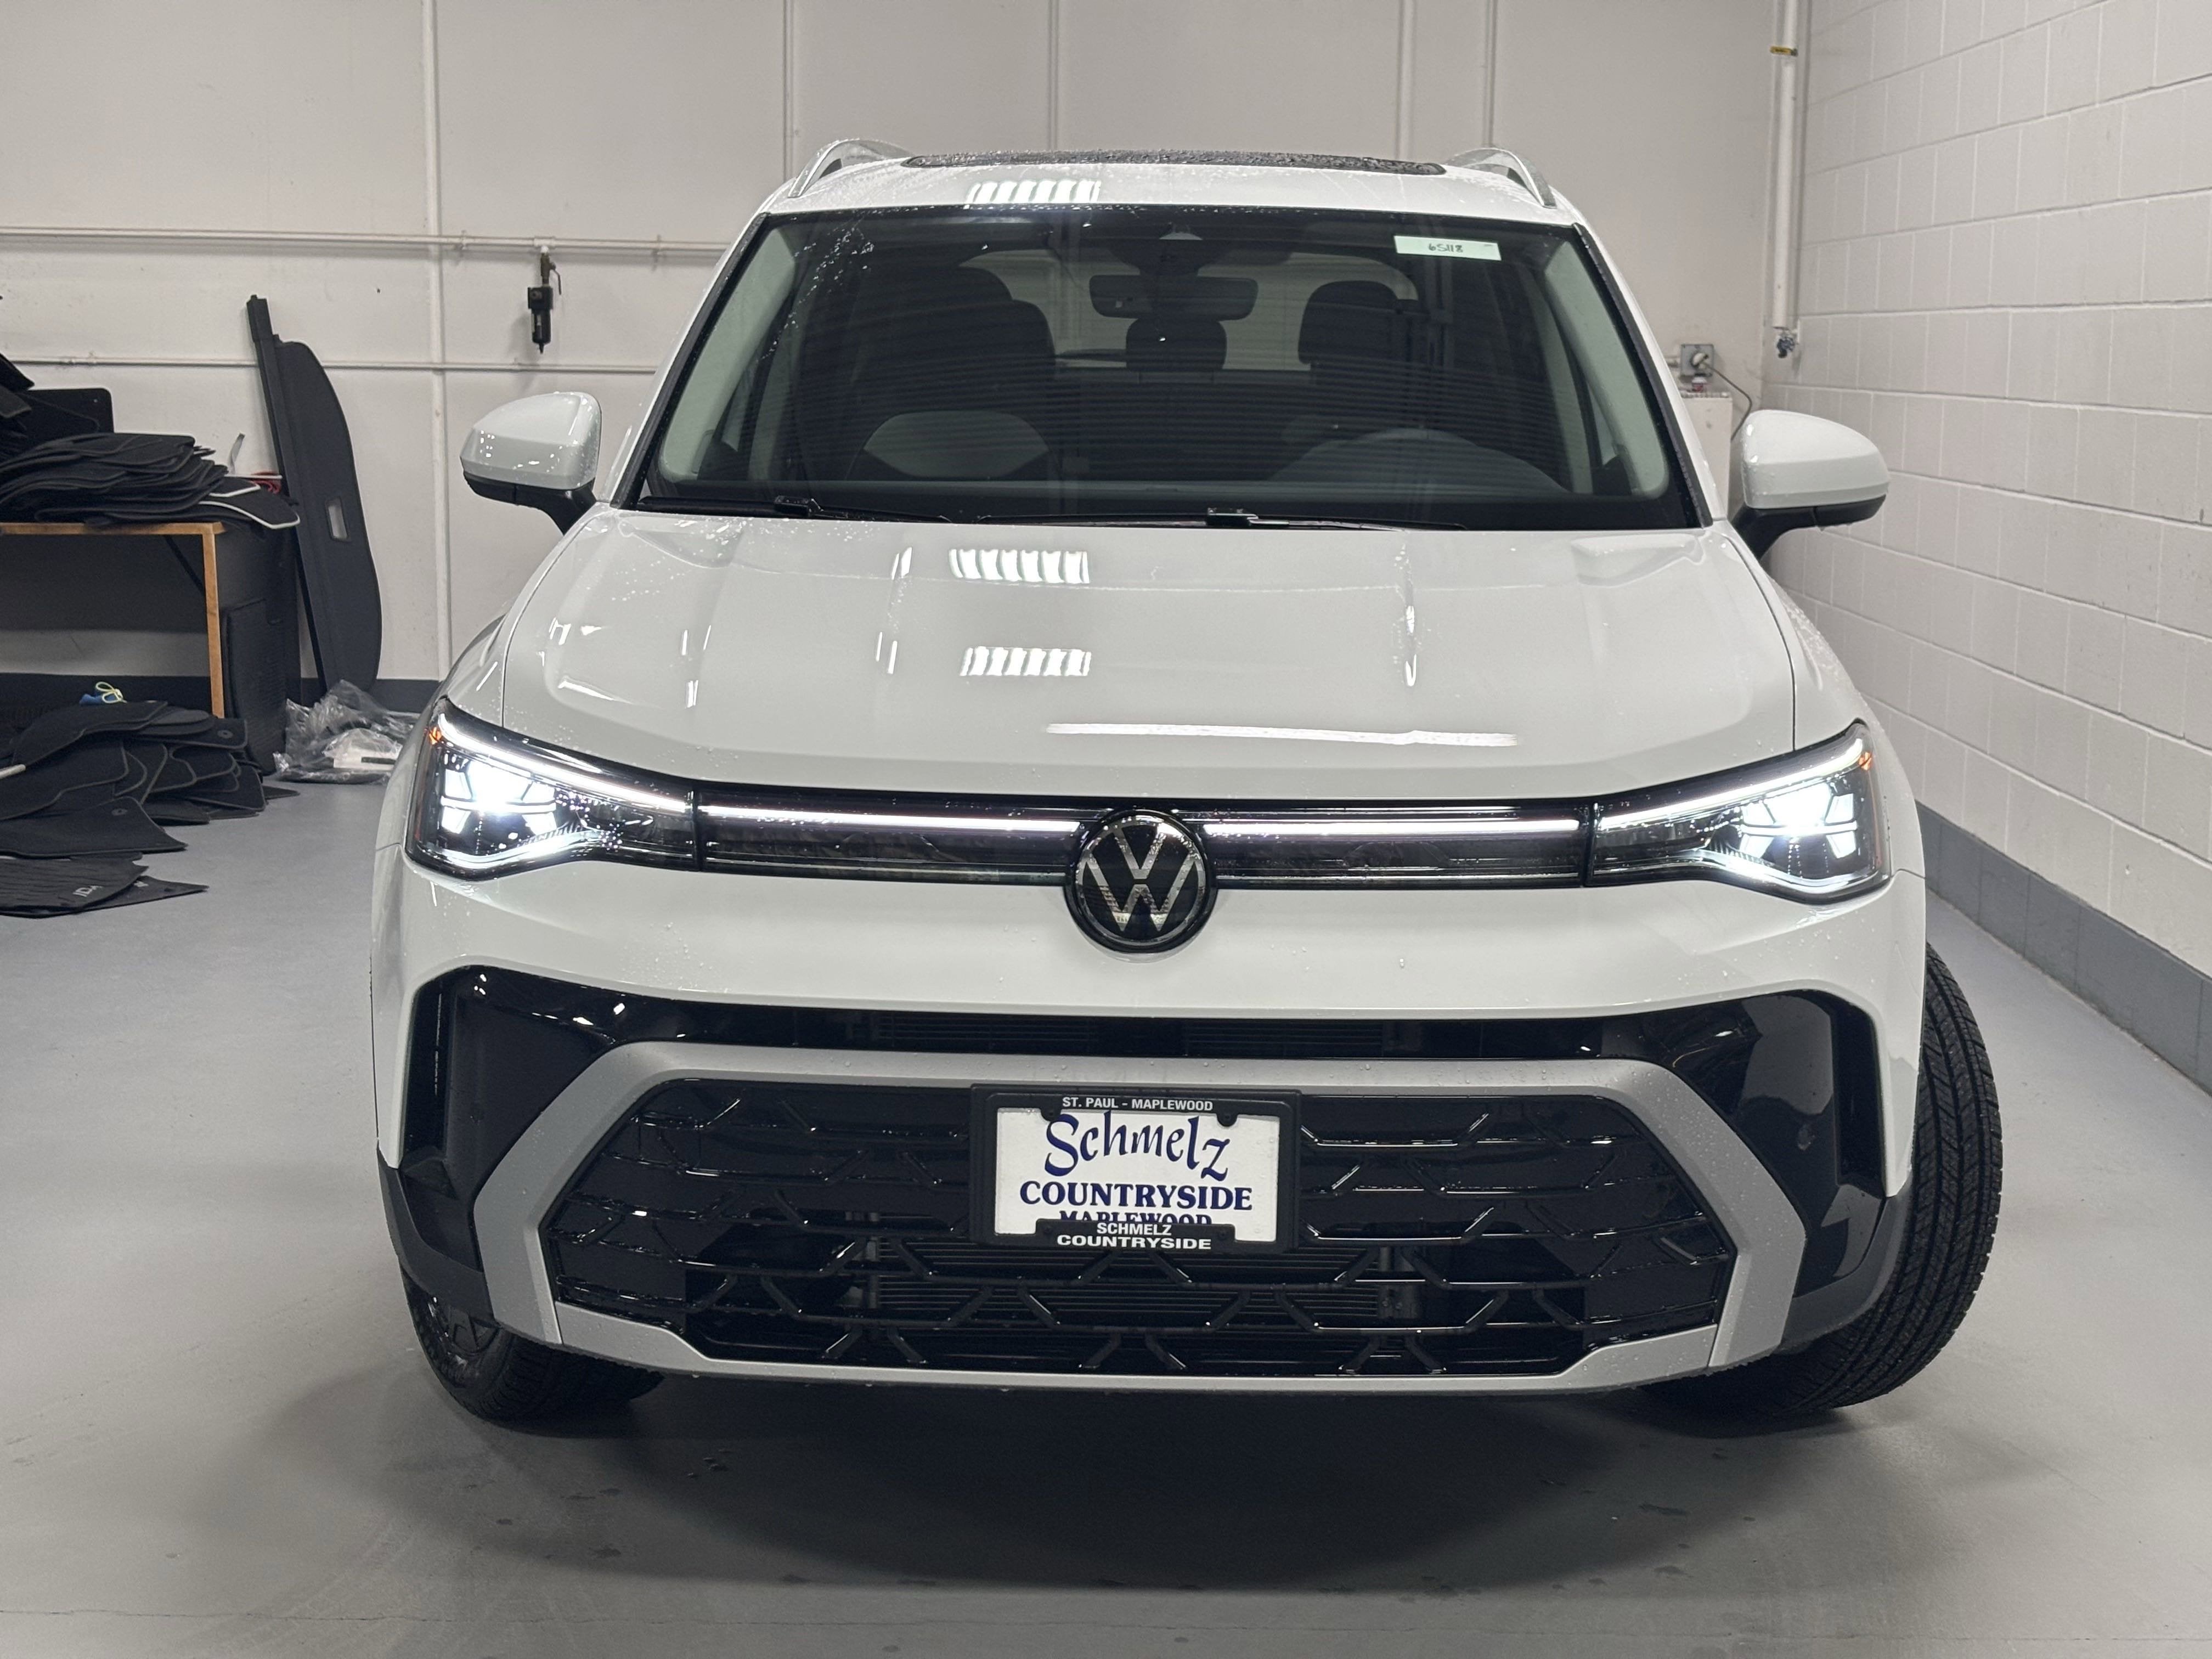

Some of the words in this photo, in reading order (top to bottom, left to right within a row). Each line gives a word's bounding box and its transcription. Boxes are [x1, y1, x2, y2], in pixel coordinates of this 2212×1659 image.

[1062, 1097, 1082, 1107] ST.
[1086, 1098, 1119, 1108] PAUL
[1132, 1099, 1213, 1111] MAPLEWOOD
[1045, 1110, 1230, 1181] Schmelz
[1020, 1181, 1252, 1210] COUNTRYSIDE
[1097, 1222, 1172, 1235] SCHMELZ
[1057, 1234, 1212, 1250] COUNTRYSIDE
